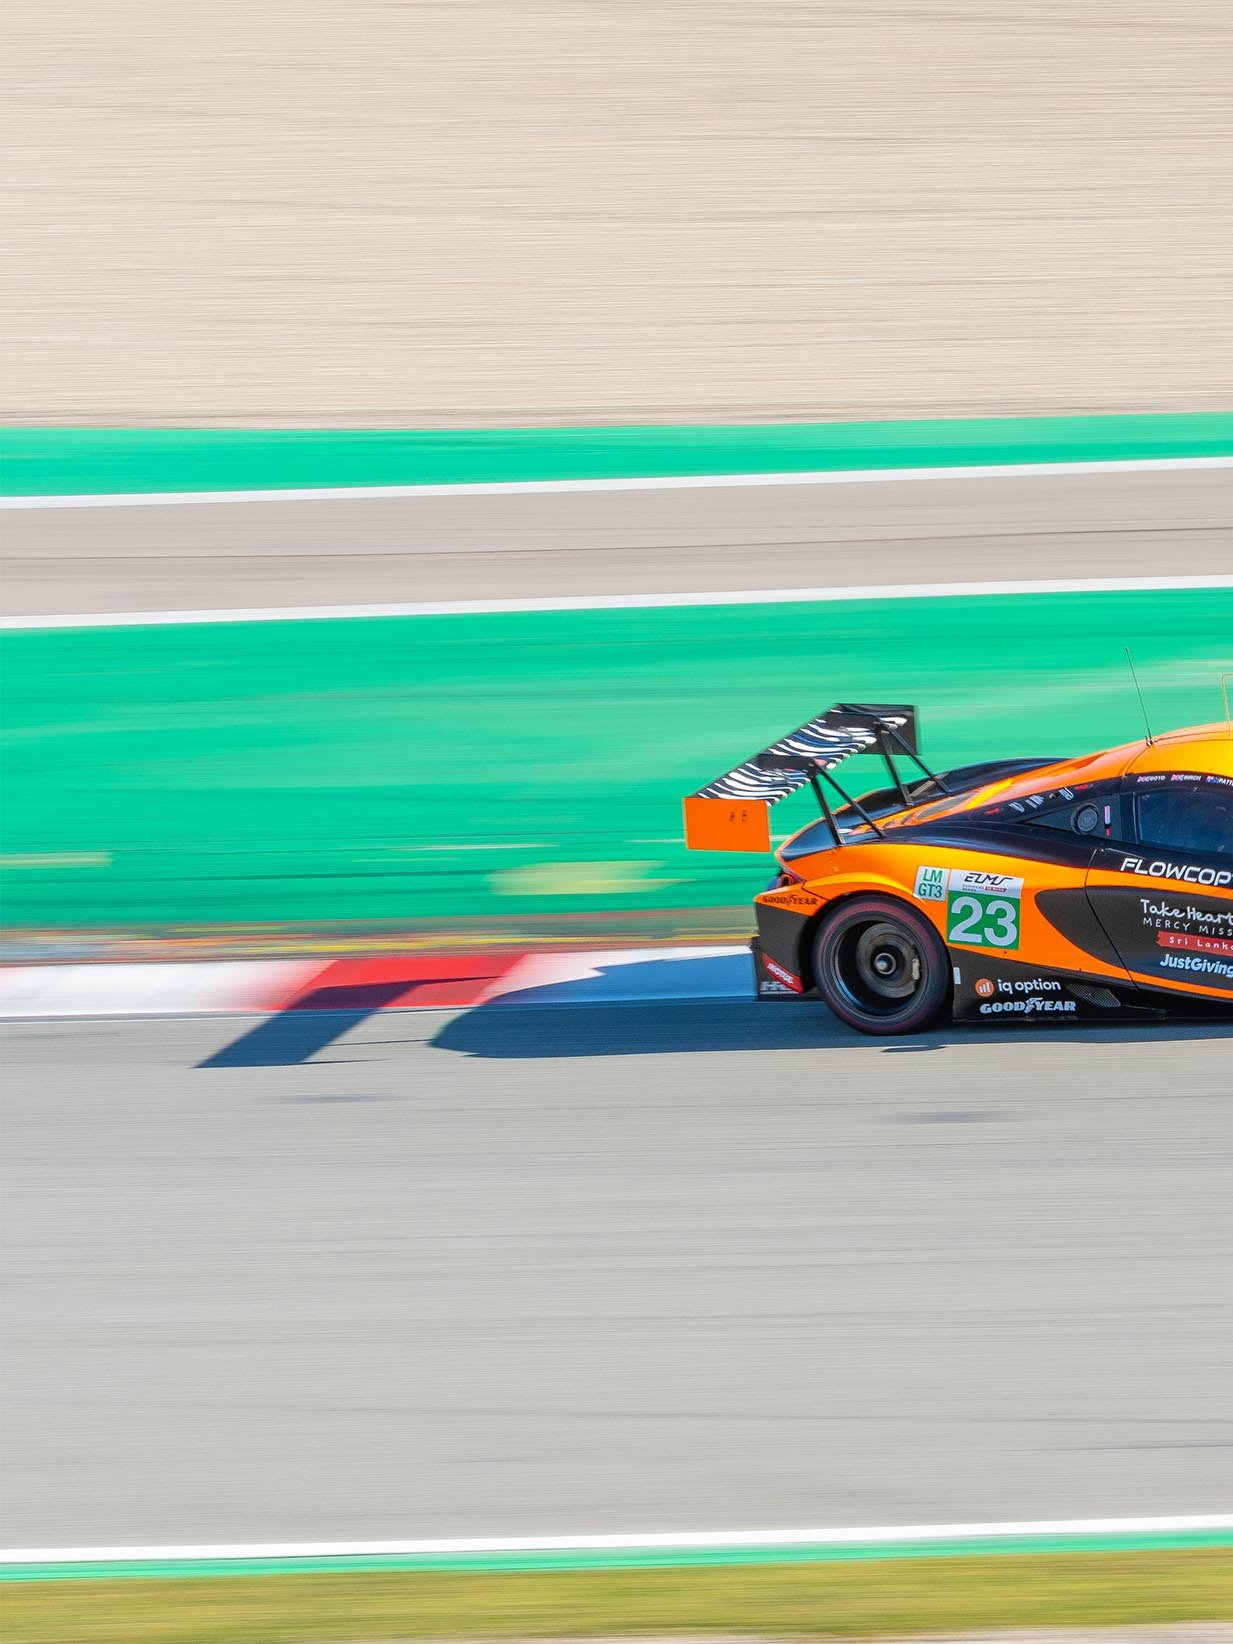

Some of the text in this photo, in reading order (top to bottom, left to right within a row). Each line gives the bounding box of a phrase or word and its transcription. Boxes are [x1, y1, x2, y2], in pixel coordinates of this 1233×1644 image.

[923, 868, 943, 883] LM
[964, 872, 1013, 885] ELMS
[918, 882, 943, 898] GT3
[1140, 899, 1186, 917] Take
[949, 896, 1018, 947] 23
[1142, 917, 1191, 931] MERCY
[1169, 936, 1188, 945] Sri
[997, 978, 1061, 994] iq option
[980, 997, 1076, 1014] GOODYEAR
